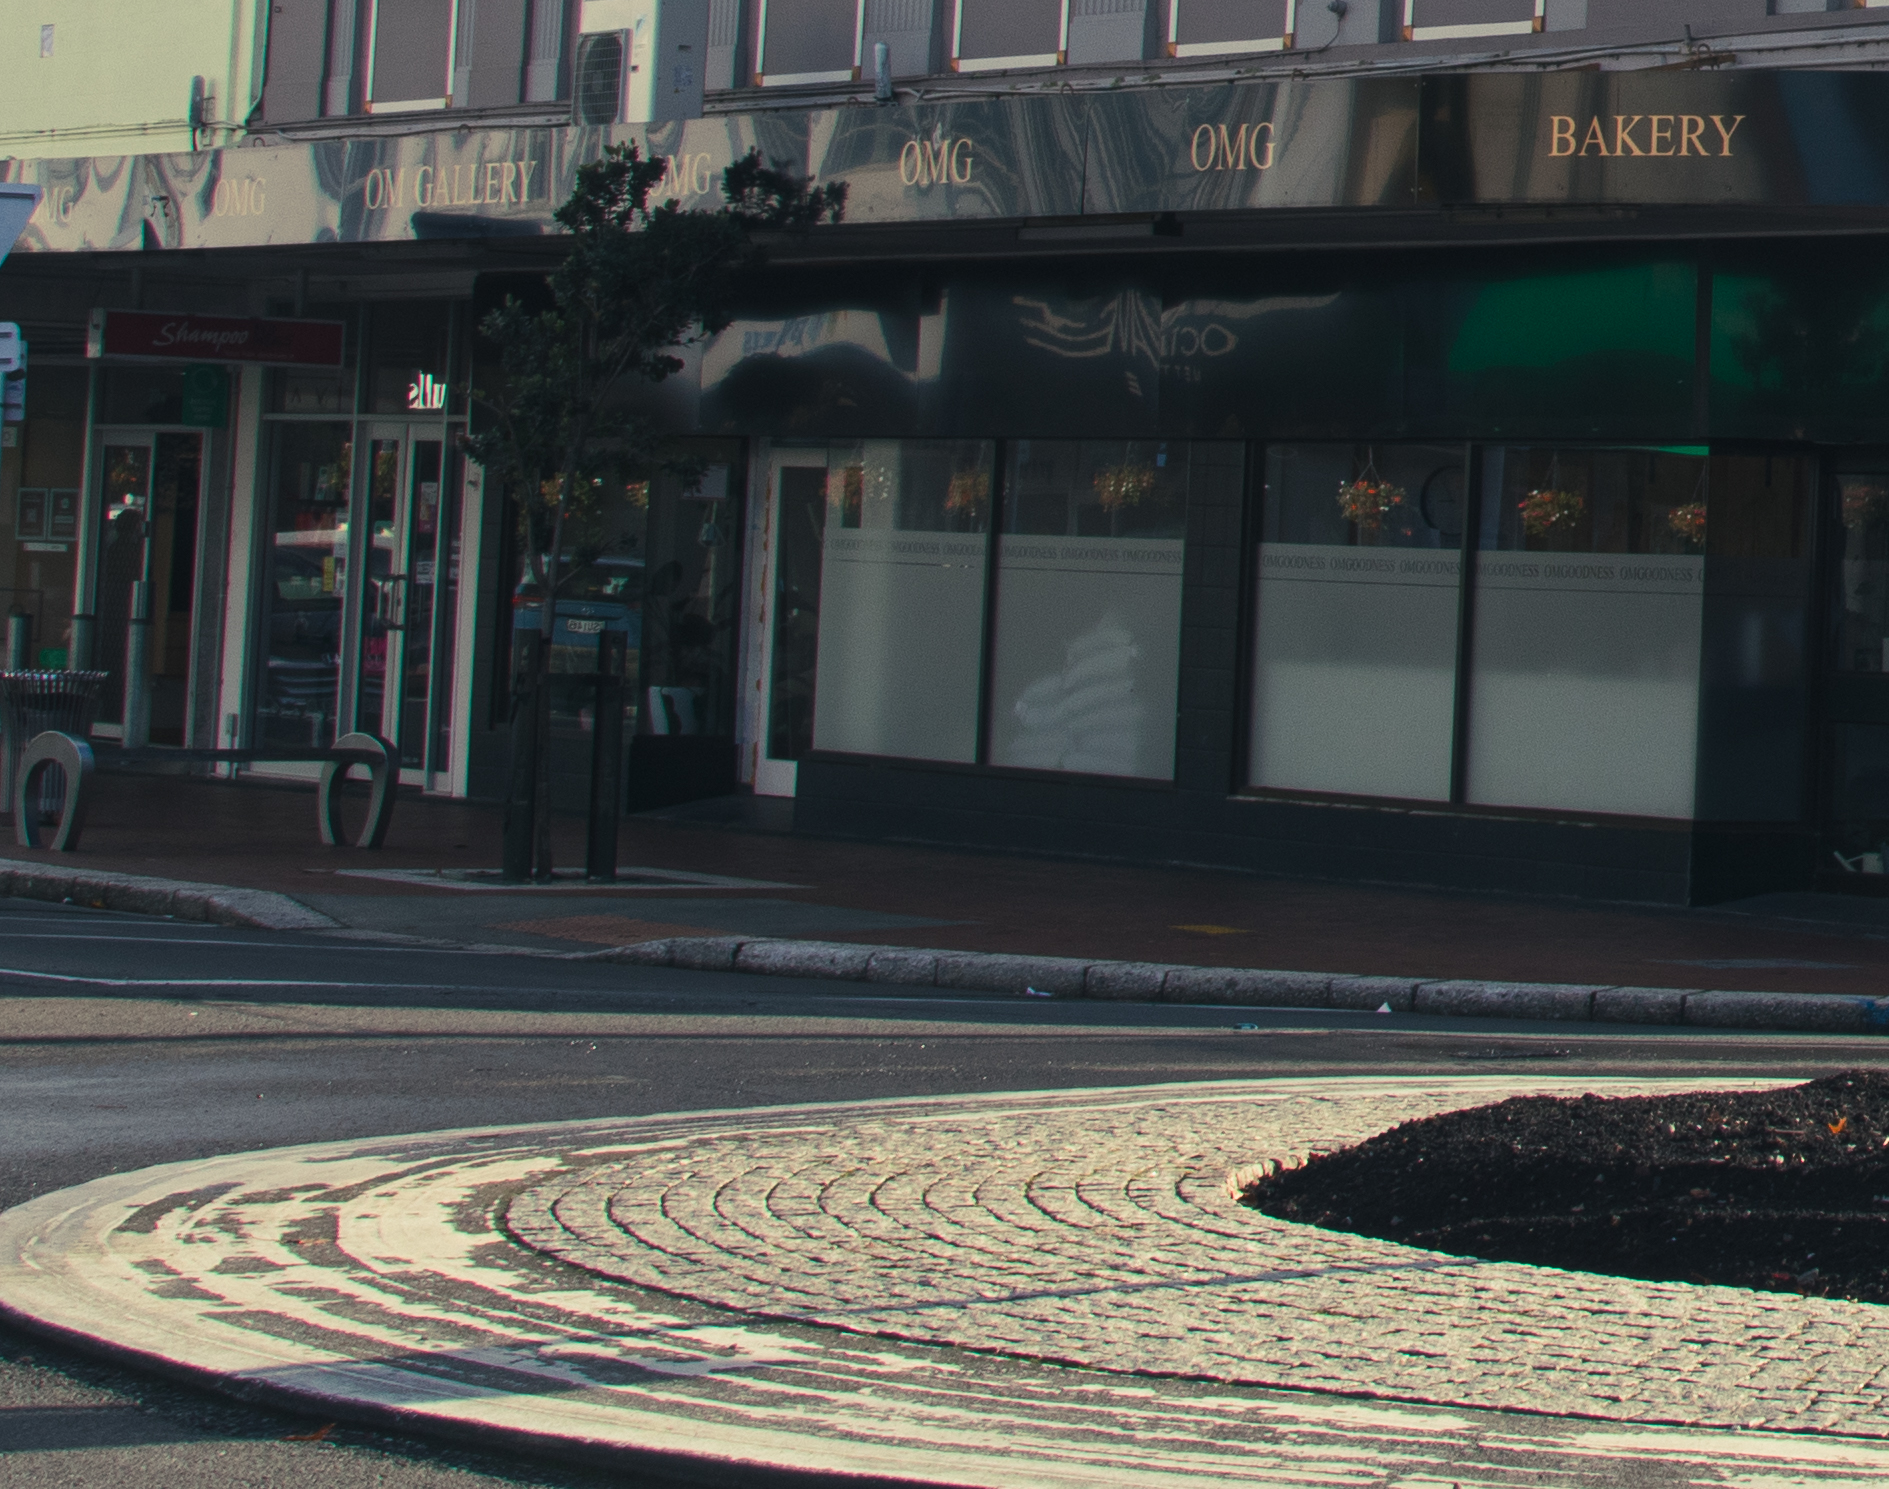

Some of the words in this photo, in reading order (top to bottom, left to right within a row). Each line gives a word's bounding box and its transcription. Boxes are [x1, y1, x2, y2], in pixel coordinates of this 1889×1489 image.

[1190, 122, 1277, 172] OMG
[1548, 115, 1747, 157] BAKERY
[900, 137, 974, 186] OMG
[42, 187, 74, 224] MG
[214, 177, 267, 217] OMG
[365, 167, 400, 210] OM
[414, 161, 538, 208] GALLERY
[151, 321, 250, 352] Shampoo
[1543, 563, 1615, 580] OMGOODNESS
[1620, 565, 1693, 582] OMGOODNESS
